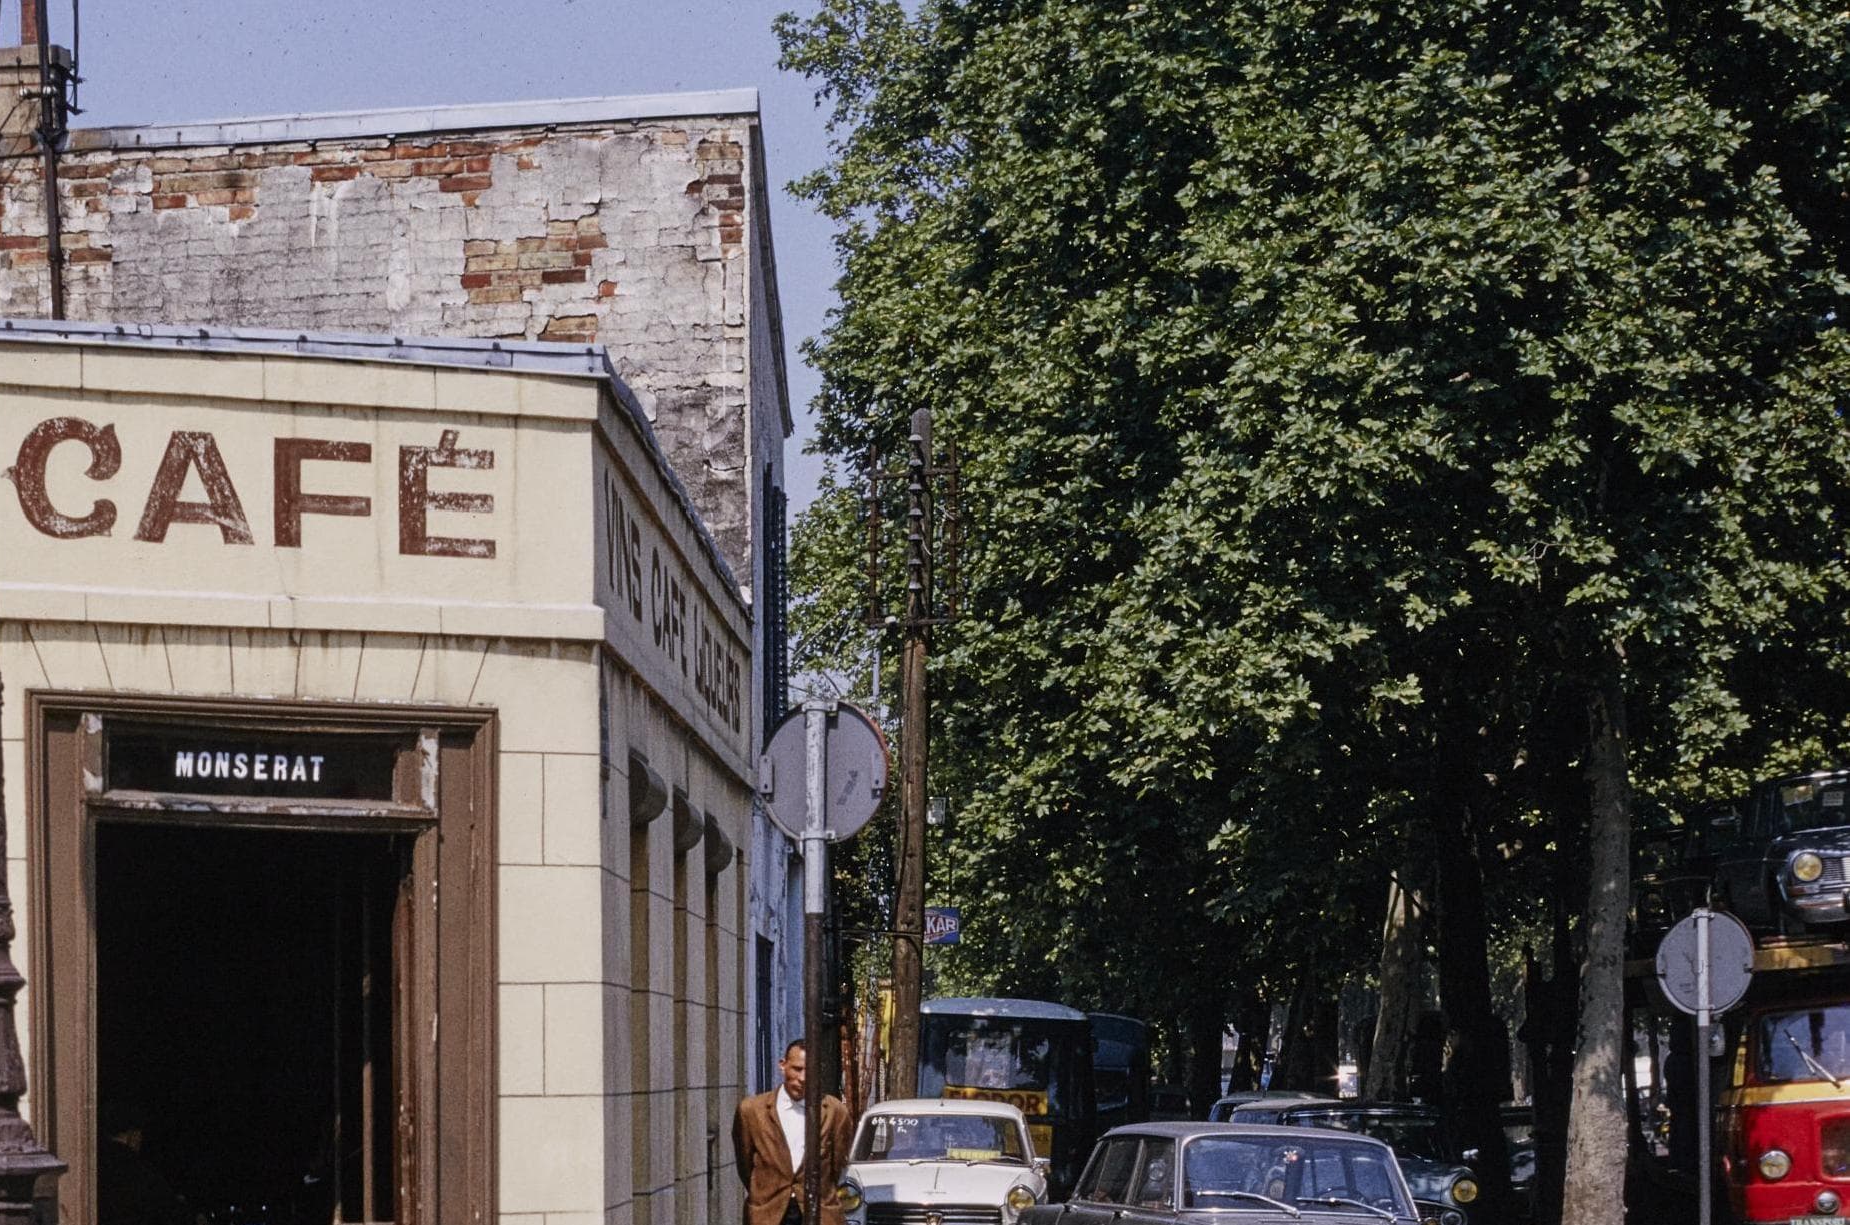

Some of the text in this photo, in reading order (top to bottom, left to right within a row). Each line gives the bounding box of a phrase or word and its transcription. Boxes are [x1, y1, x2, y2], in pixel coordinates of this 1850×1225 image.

[1, 416, 497, 559] CAFÉ
[604, 467, 643, 624] VINS
[175, 751, 324, 782] MONSERAT
[924, 916, 956, 934] KAR
